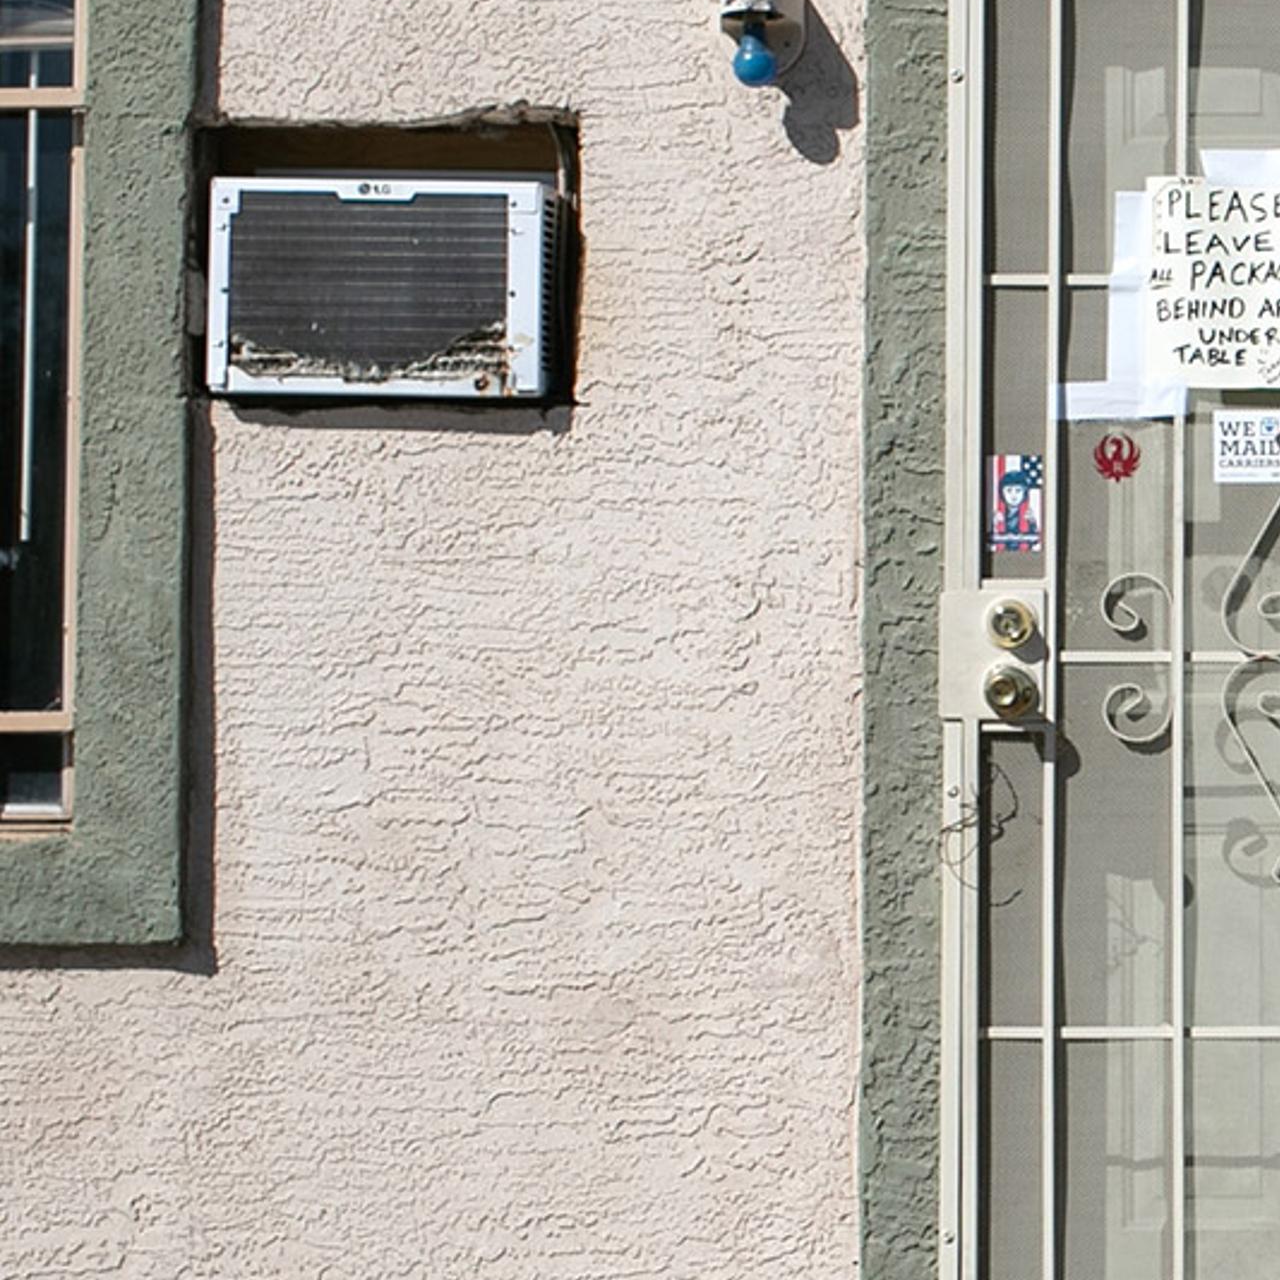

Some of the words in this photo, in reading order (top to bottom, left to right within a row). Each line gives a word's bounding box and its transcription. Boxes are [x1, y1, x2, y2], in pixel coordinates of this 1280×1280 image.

[1163, 229, 1274, 256] LEAVE
[1149, 268, 1173, 282] ALL
[1156, 297, 1246, 322] BEHIND
[1172, 343, 1247, 367] TABLE
[1219, 420, 1256, 437] WE
[1220, 439, 1280, 456] MAIL
